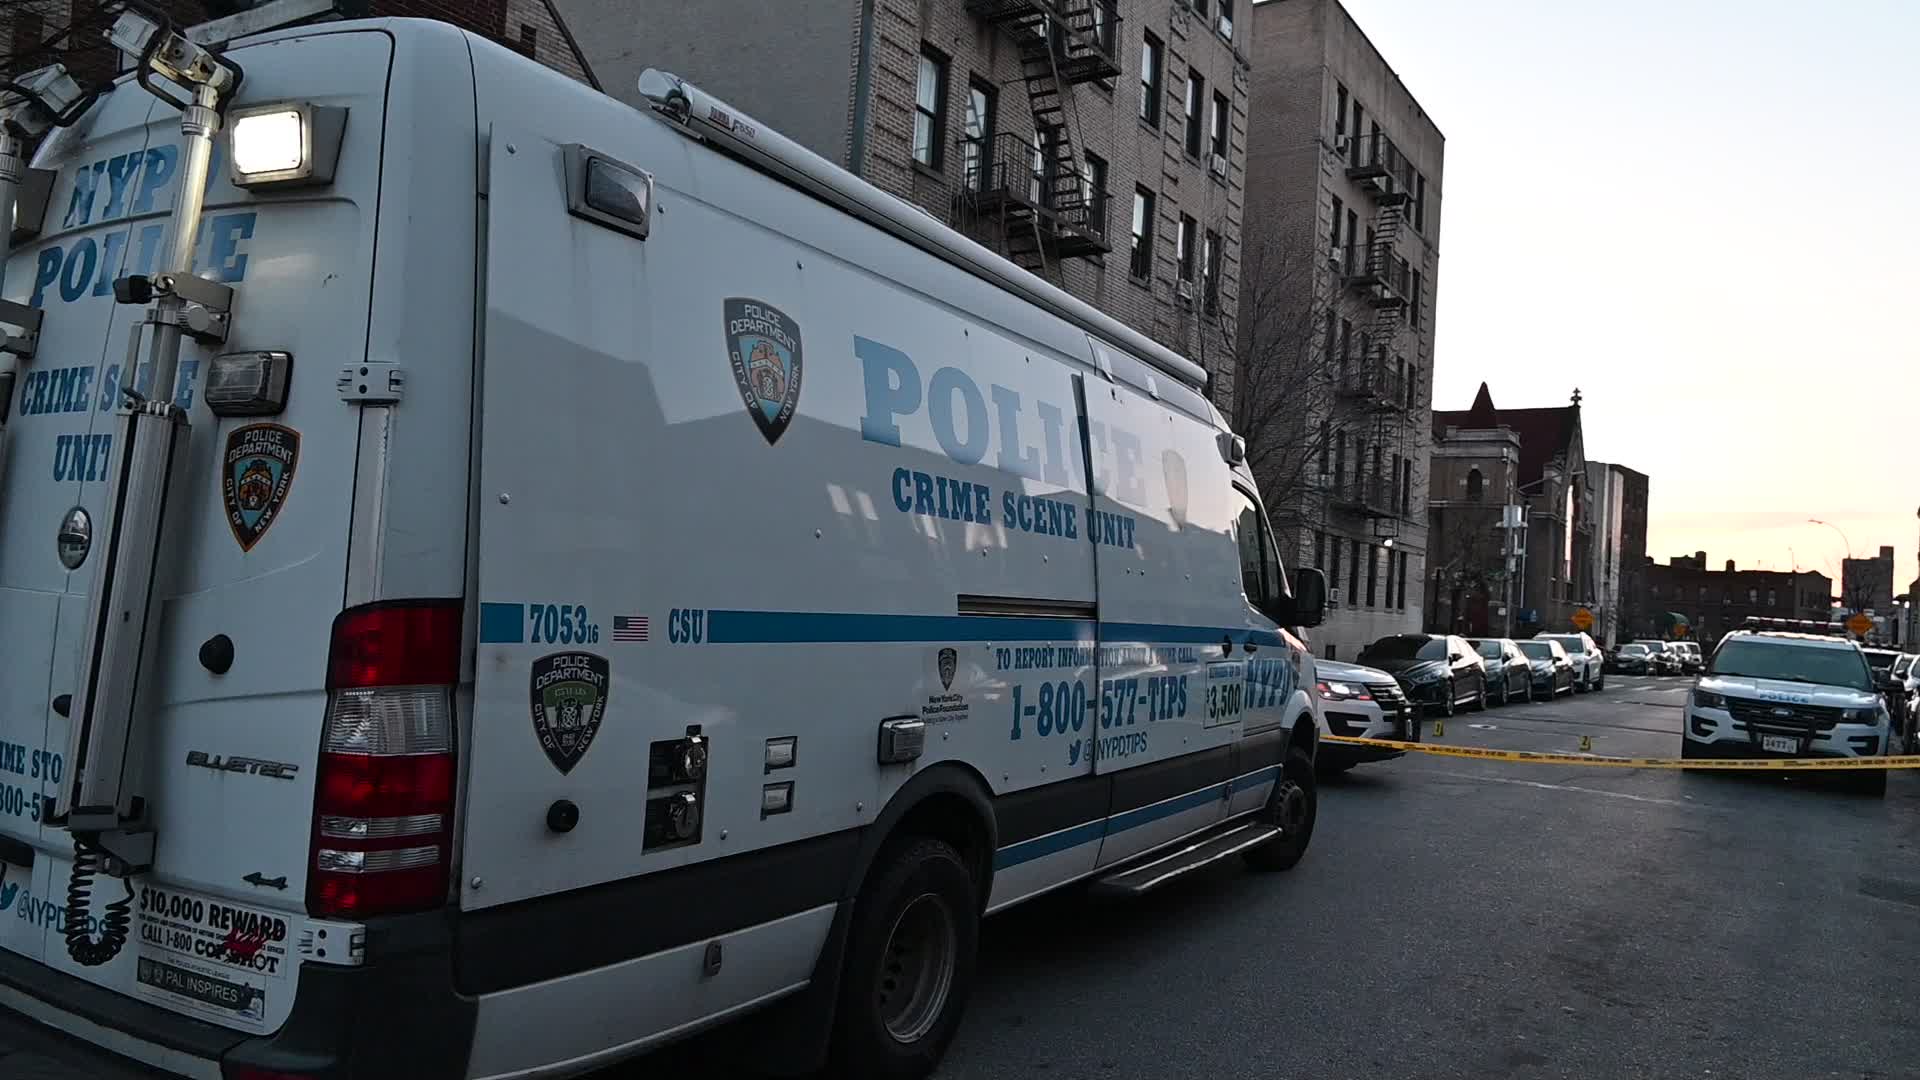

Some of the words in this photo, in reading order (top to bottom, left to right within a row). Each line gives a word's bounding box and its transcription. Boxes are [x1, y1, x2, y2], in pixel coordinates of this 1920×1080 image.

[63, 144, 221, 229] NYP
[744, 304, 782, 328] POLICE
[731, 319, 796, 352] DEPARTMENT
[19, 366, 95, 416] CRIME
[732, 351, 748, 386] CITY
[745, 391, 759, 410] OF
[245, 429, 283, 444] POLICE
[854, 335, 1149, 508] POLICE
[228, 441, 293, 464] DEPARTMENT
[254, 509, 273, 533] NEW
[272, 471, 290, 503] YORK
[892, 467, 991, 525] CRIME
[1003, 491, 1077, 539] SCENE
[1086, 507, 1135, 549] UNIT
[530, 604, 588, 645] 7053
[668, 608, 704, 644] CSU
[553, 655, 591, 669] POLICE
[997, 648, 1011, 670] TO
[1015, 647, 1054, 670] REPORT
[535, 668, 605, 690] DEPARTMENT
[1244, 659, 1291, 711] NYPD
[534, 703, 550, 733] CITY
[543, 733, 556, 750] OF
[186, 750, 299, 780] BLUETEC
[140, 887, 203, 924] $10,000
[208, 903, 286, 942] REWARD
[142, 923, 163, 945] CALL
[166, 931, 193, 952] 1-800
[166, 969, 184, 987] PAL
[186, 976, 239, 1003] INSPIRES
